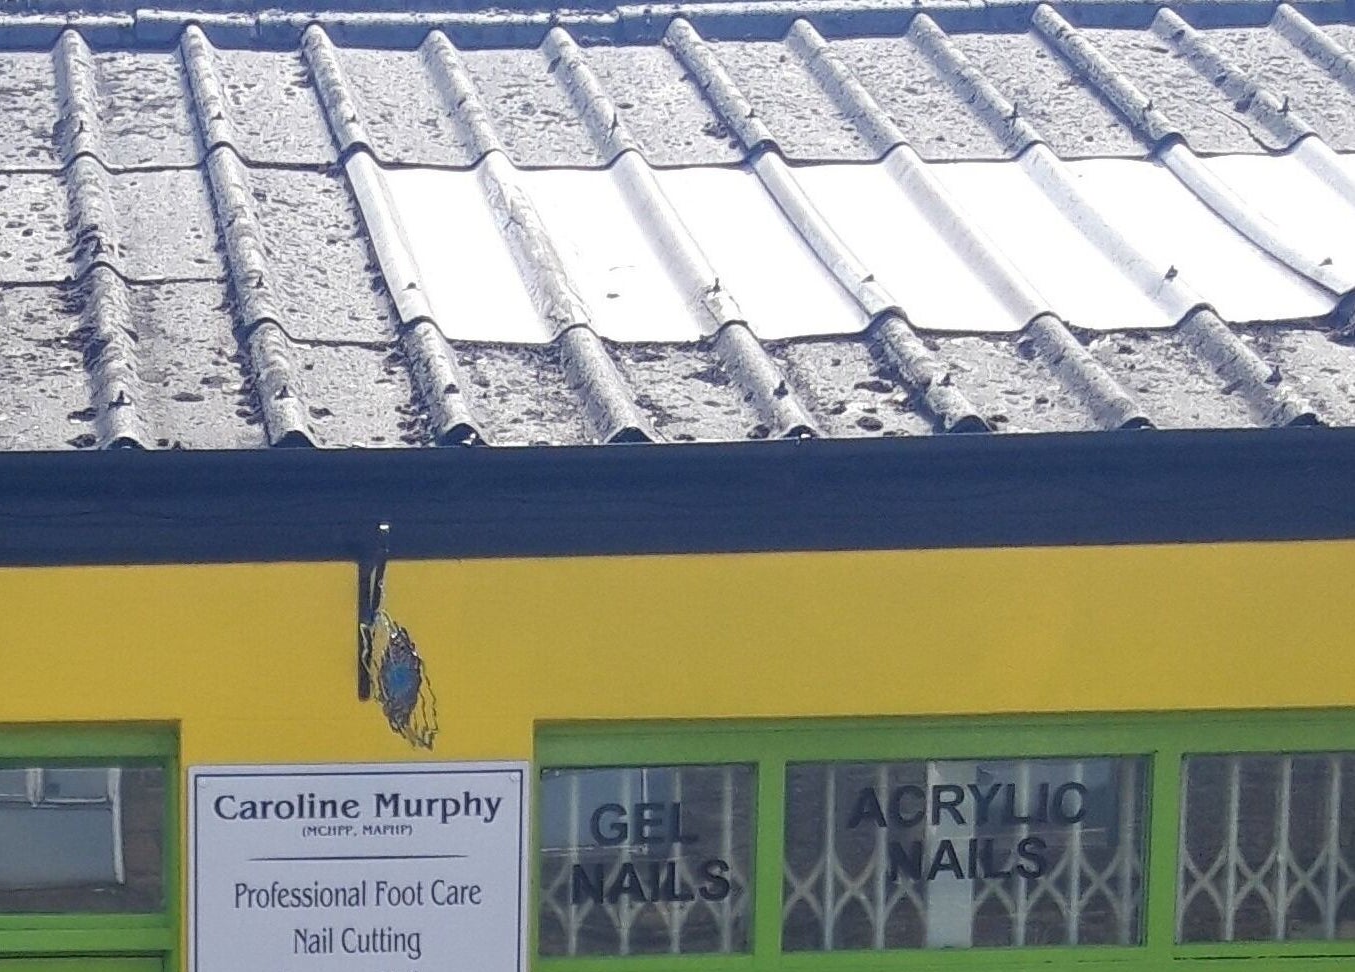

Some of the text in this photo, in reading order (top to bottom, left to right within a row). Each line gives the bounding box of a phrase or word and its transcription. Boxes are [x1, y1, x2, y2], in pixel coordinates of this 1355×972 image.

[214, 792, 502, 825] Caroline Murphy
[591, 802, 698, 846] GEL
[849, 783, 1088, 829] ACRYLIC
[889, 838, 1047, 881] NAILS
[235, 880, 481, 908] Professional Foot Care
[570, 861, 732, 905] NAILS
[294, 927, 421, 960] Nail Cutting
